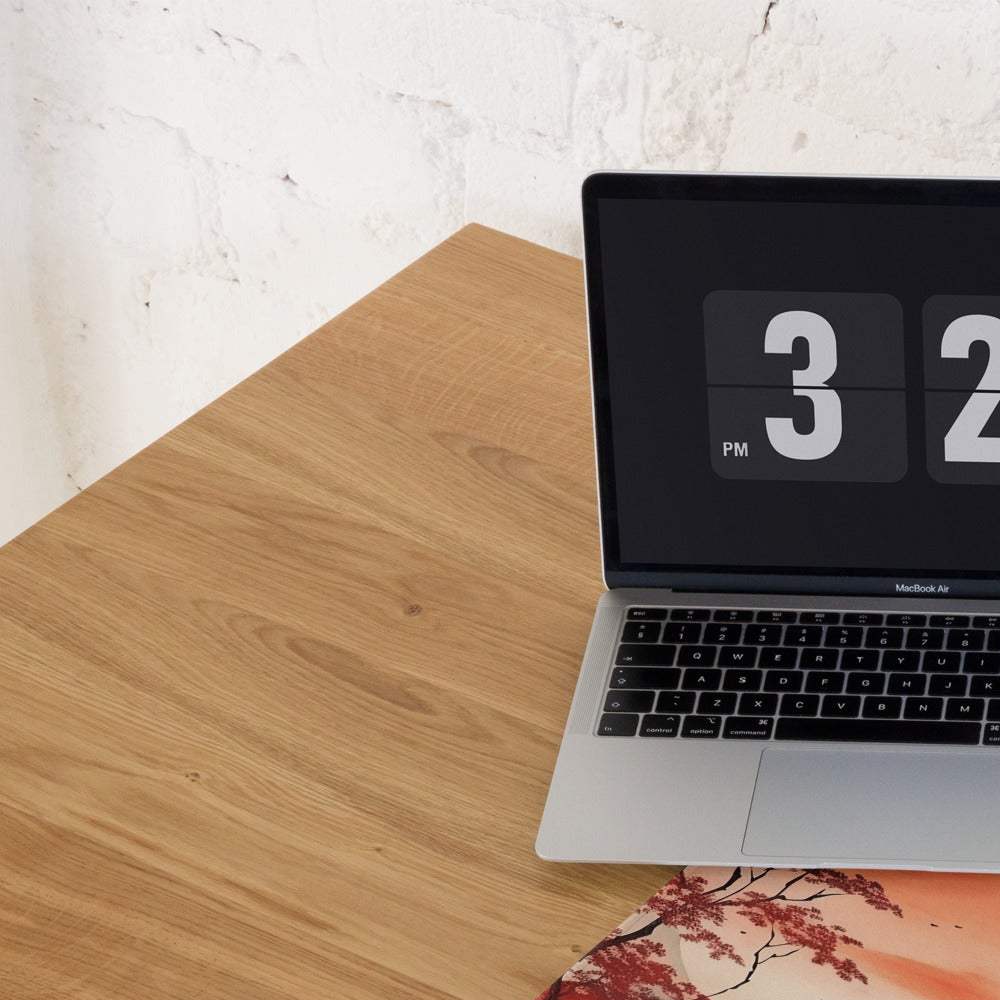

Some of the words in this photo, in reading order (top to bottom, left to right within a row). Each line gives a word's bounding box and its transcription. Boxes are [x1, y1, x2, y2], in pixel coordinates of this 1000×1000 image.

[764, 310, 843, 461] 3
[722, 441, 749, 457] PM
[895, 583, 936, 593] MacBook
[937, 584, 950, 593] Air
